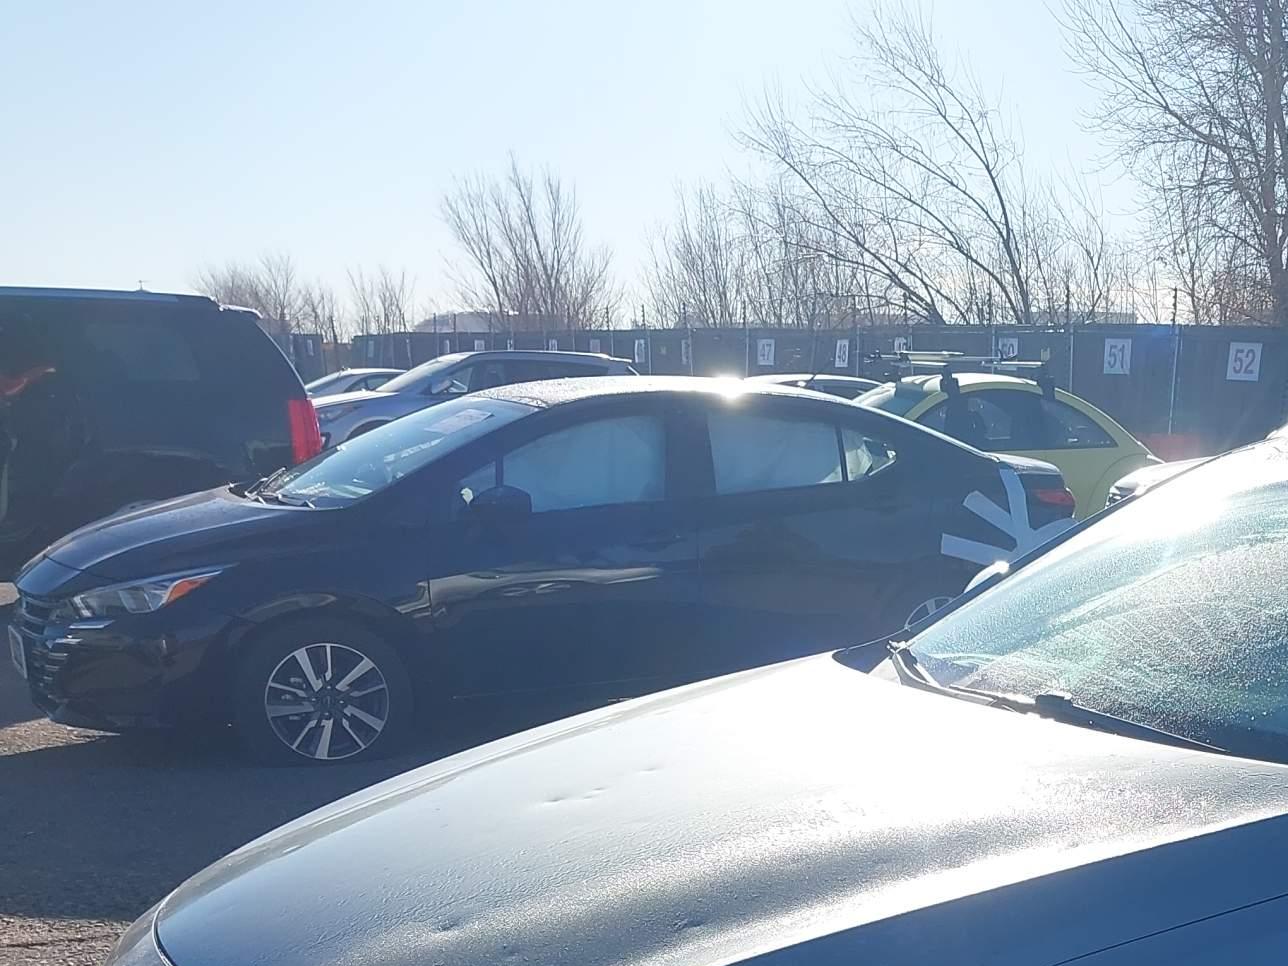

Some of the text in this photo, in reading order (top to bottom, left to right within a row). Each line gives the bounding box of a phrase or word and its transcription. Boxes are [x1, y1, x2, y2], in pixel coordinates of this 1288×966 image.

[760, 343, 773, 361] 47
[836, 343, 847, 364] 48
[1107, 343, 1127, 369] 51
[1232, 348, 1256, 375] 52
